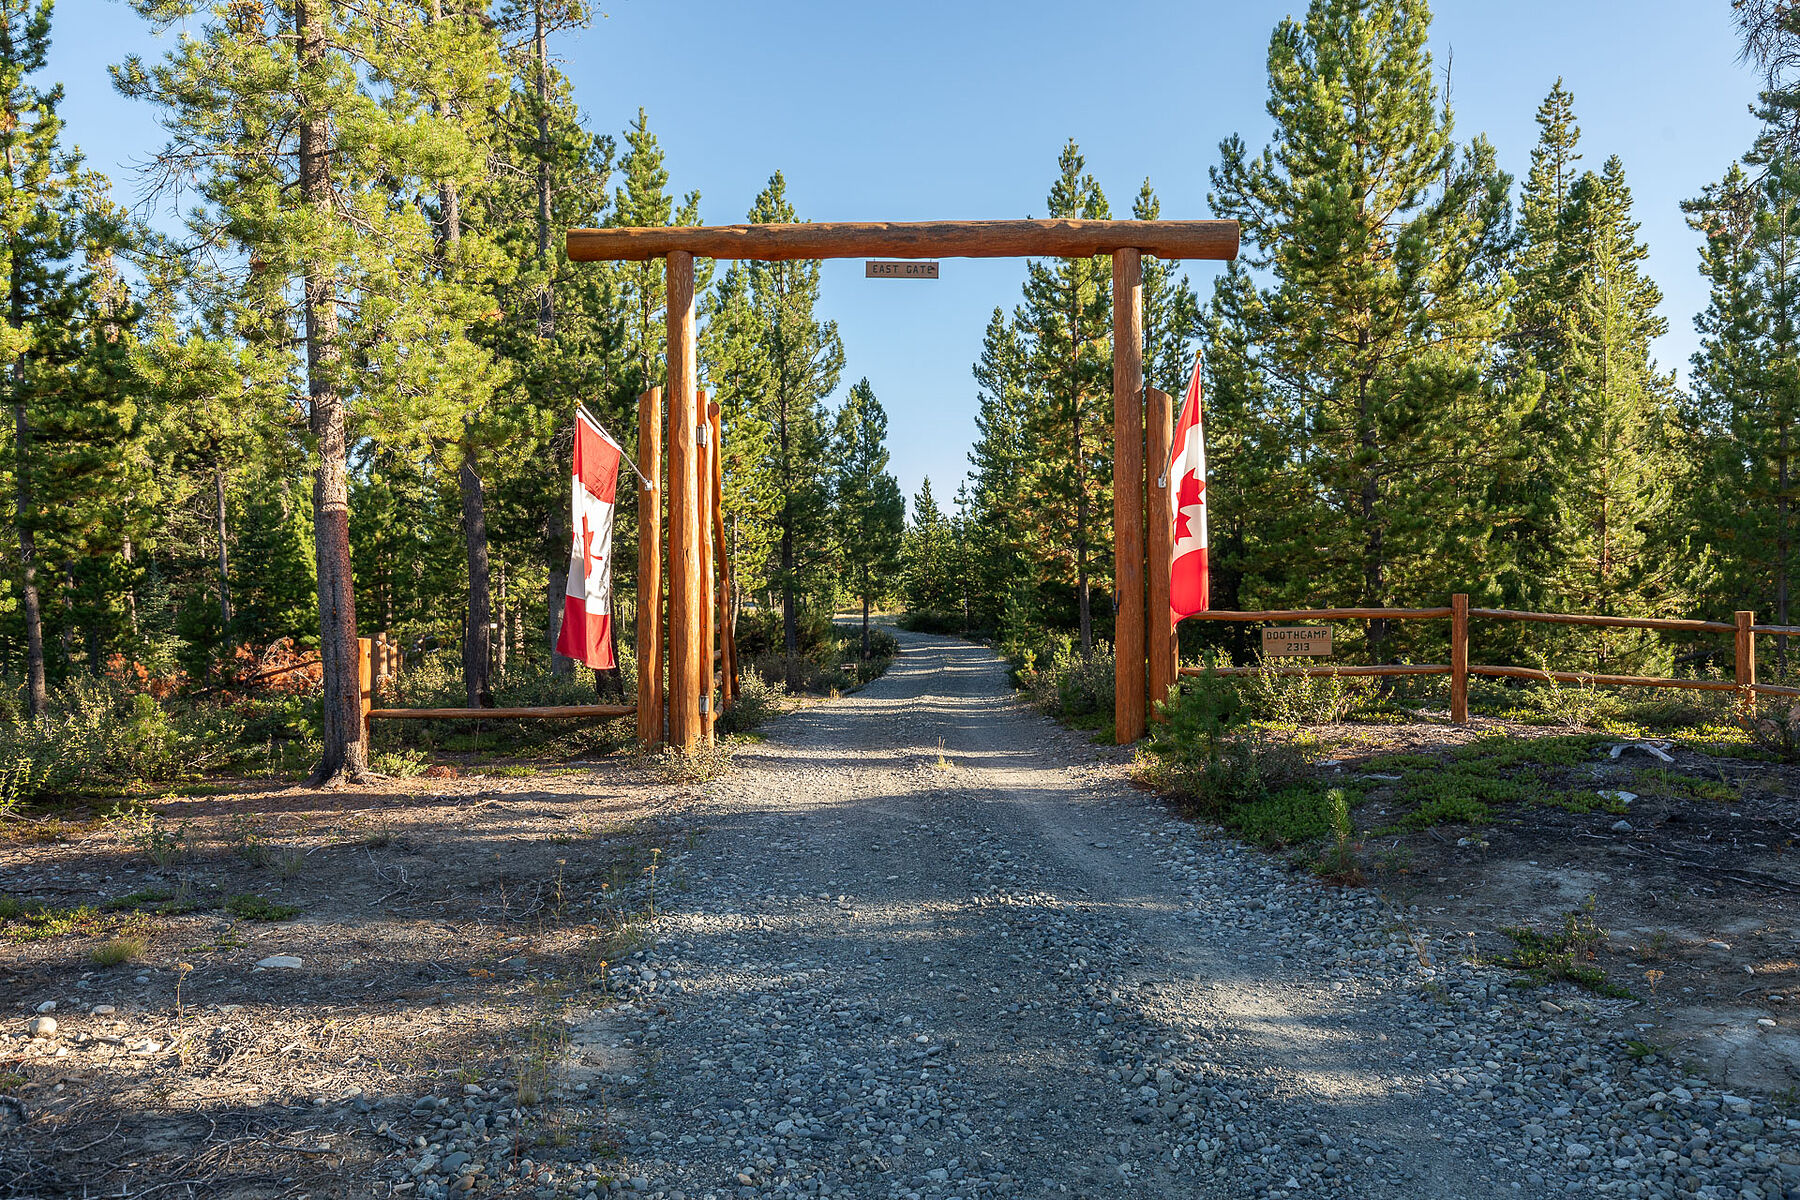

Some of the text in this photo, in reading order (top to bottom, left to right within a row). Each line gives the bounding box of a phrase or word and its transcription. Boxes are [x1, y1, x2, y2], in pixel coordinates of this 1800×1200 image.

[872, 264, 933, 274] EAST GATE
[1286, 642, 1310, 652] 2313
